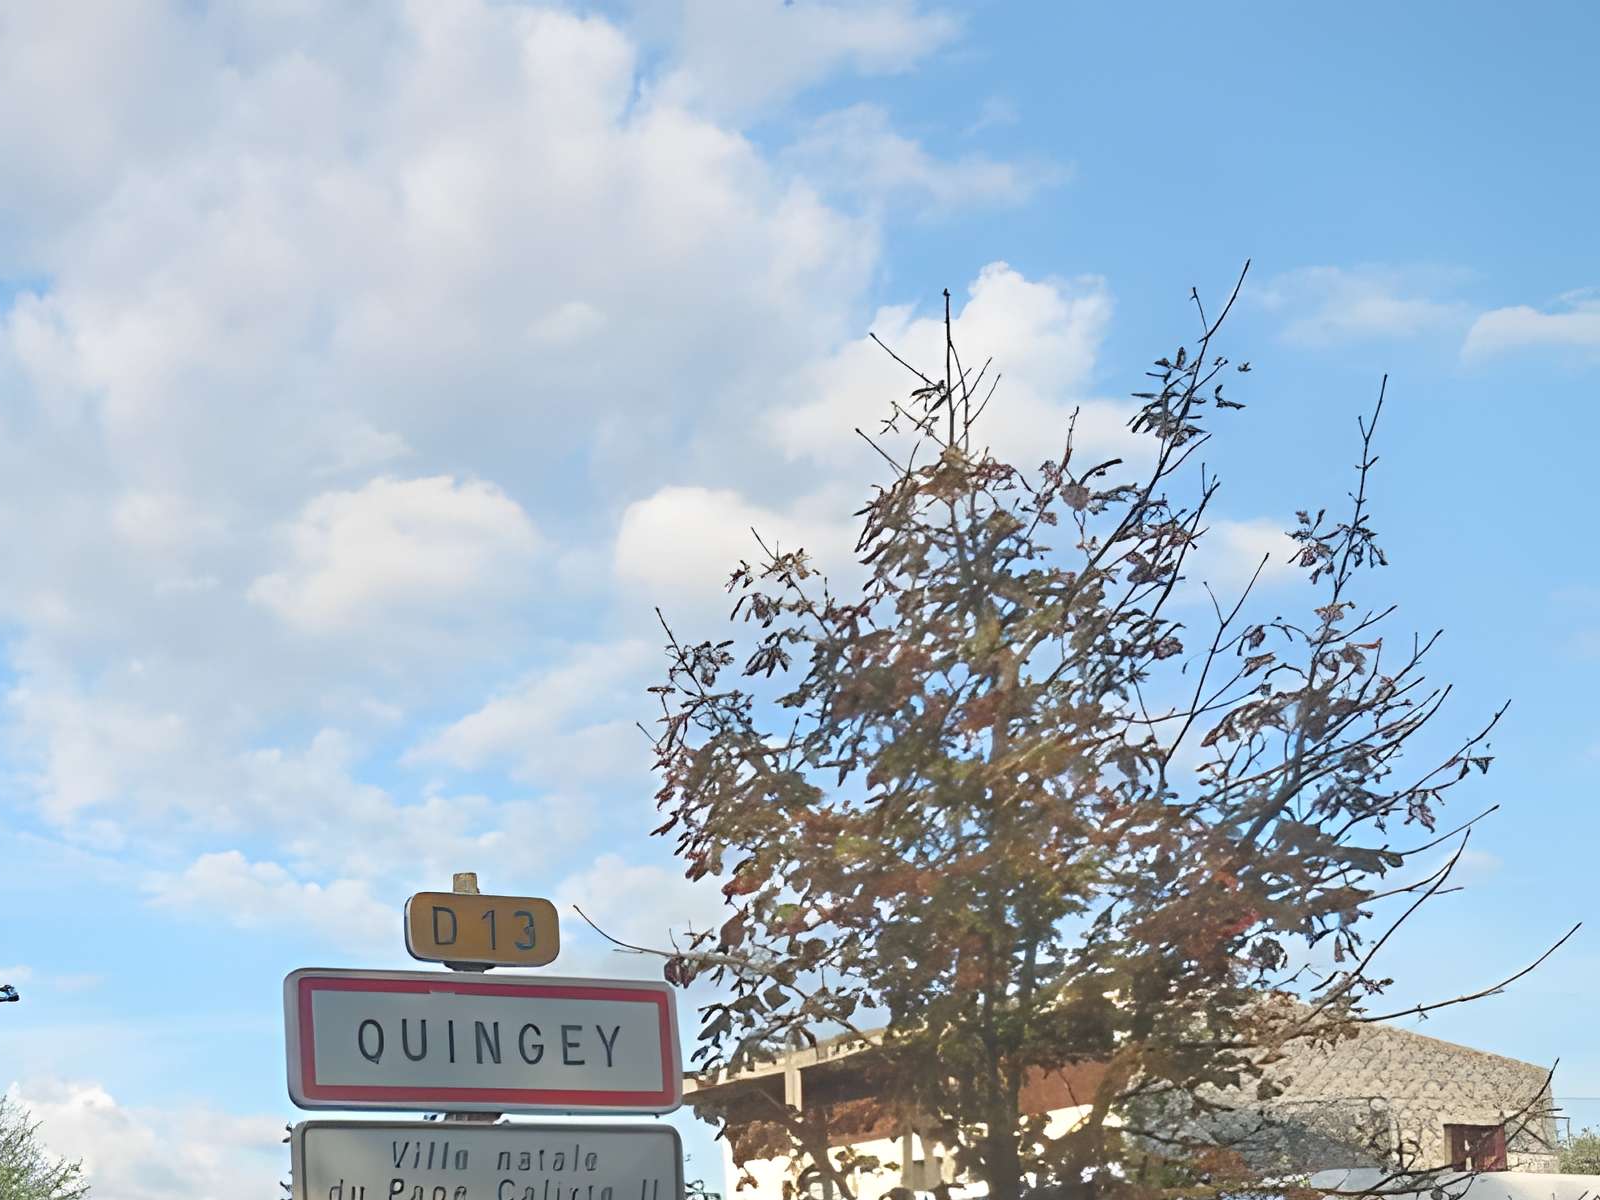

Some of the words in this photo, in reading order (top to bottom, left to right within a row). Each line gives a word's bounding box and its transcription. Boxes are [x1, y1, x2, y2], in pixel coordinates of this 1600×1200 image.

[432, 906, 457, 945] D
[481, 910, 536, 951] 13
[357, 1017, 621, 1068] QUINGEY
[497, 1143, 598, 1172] natale
